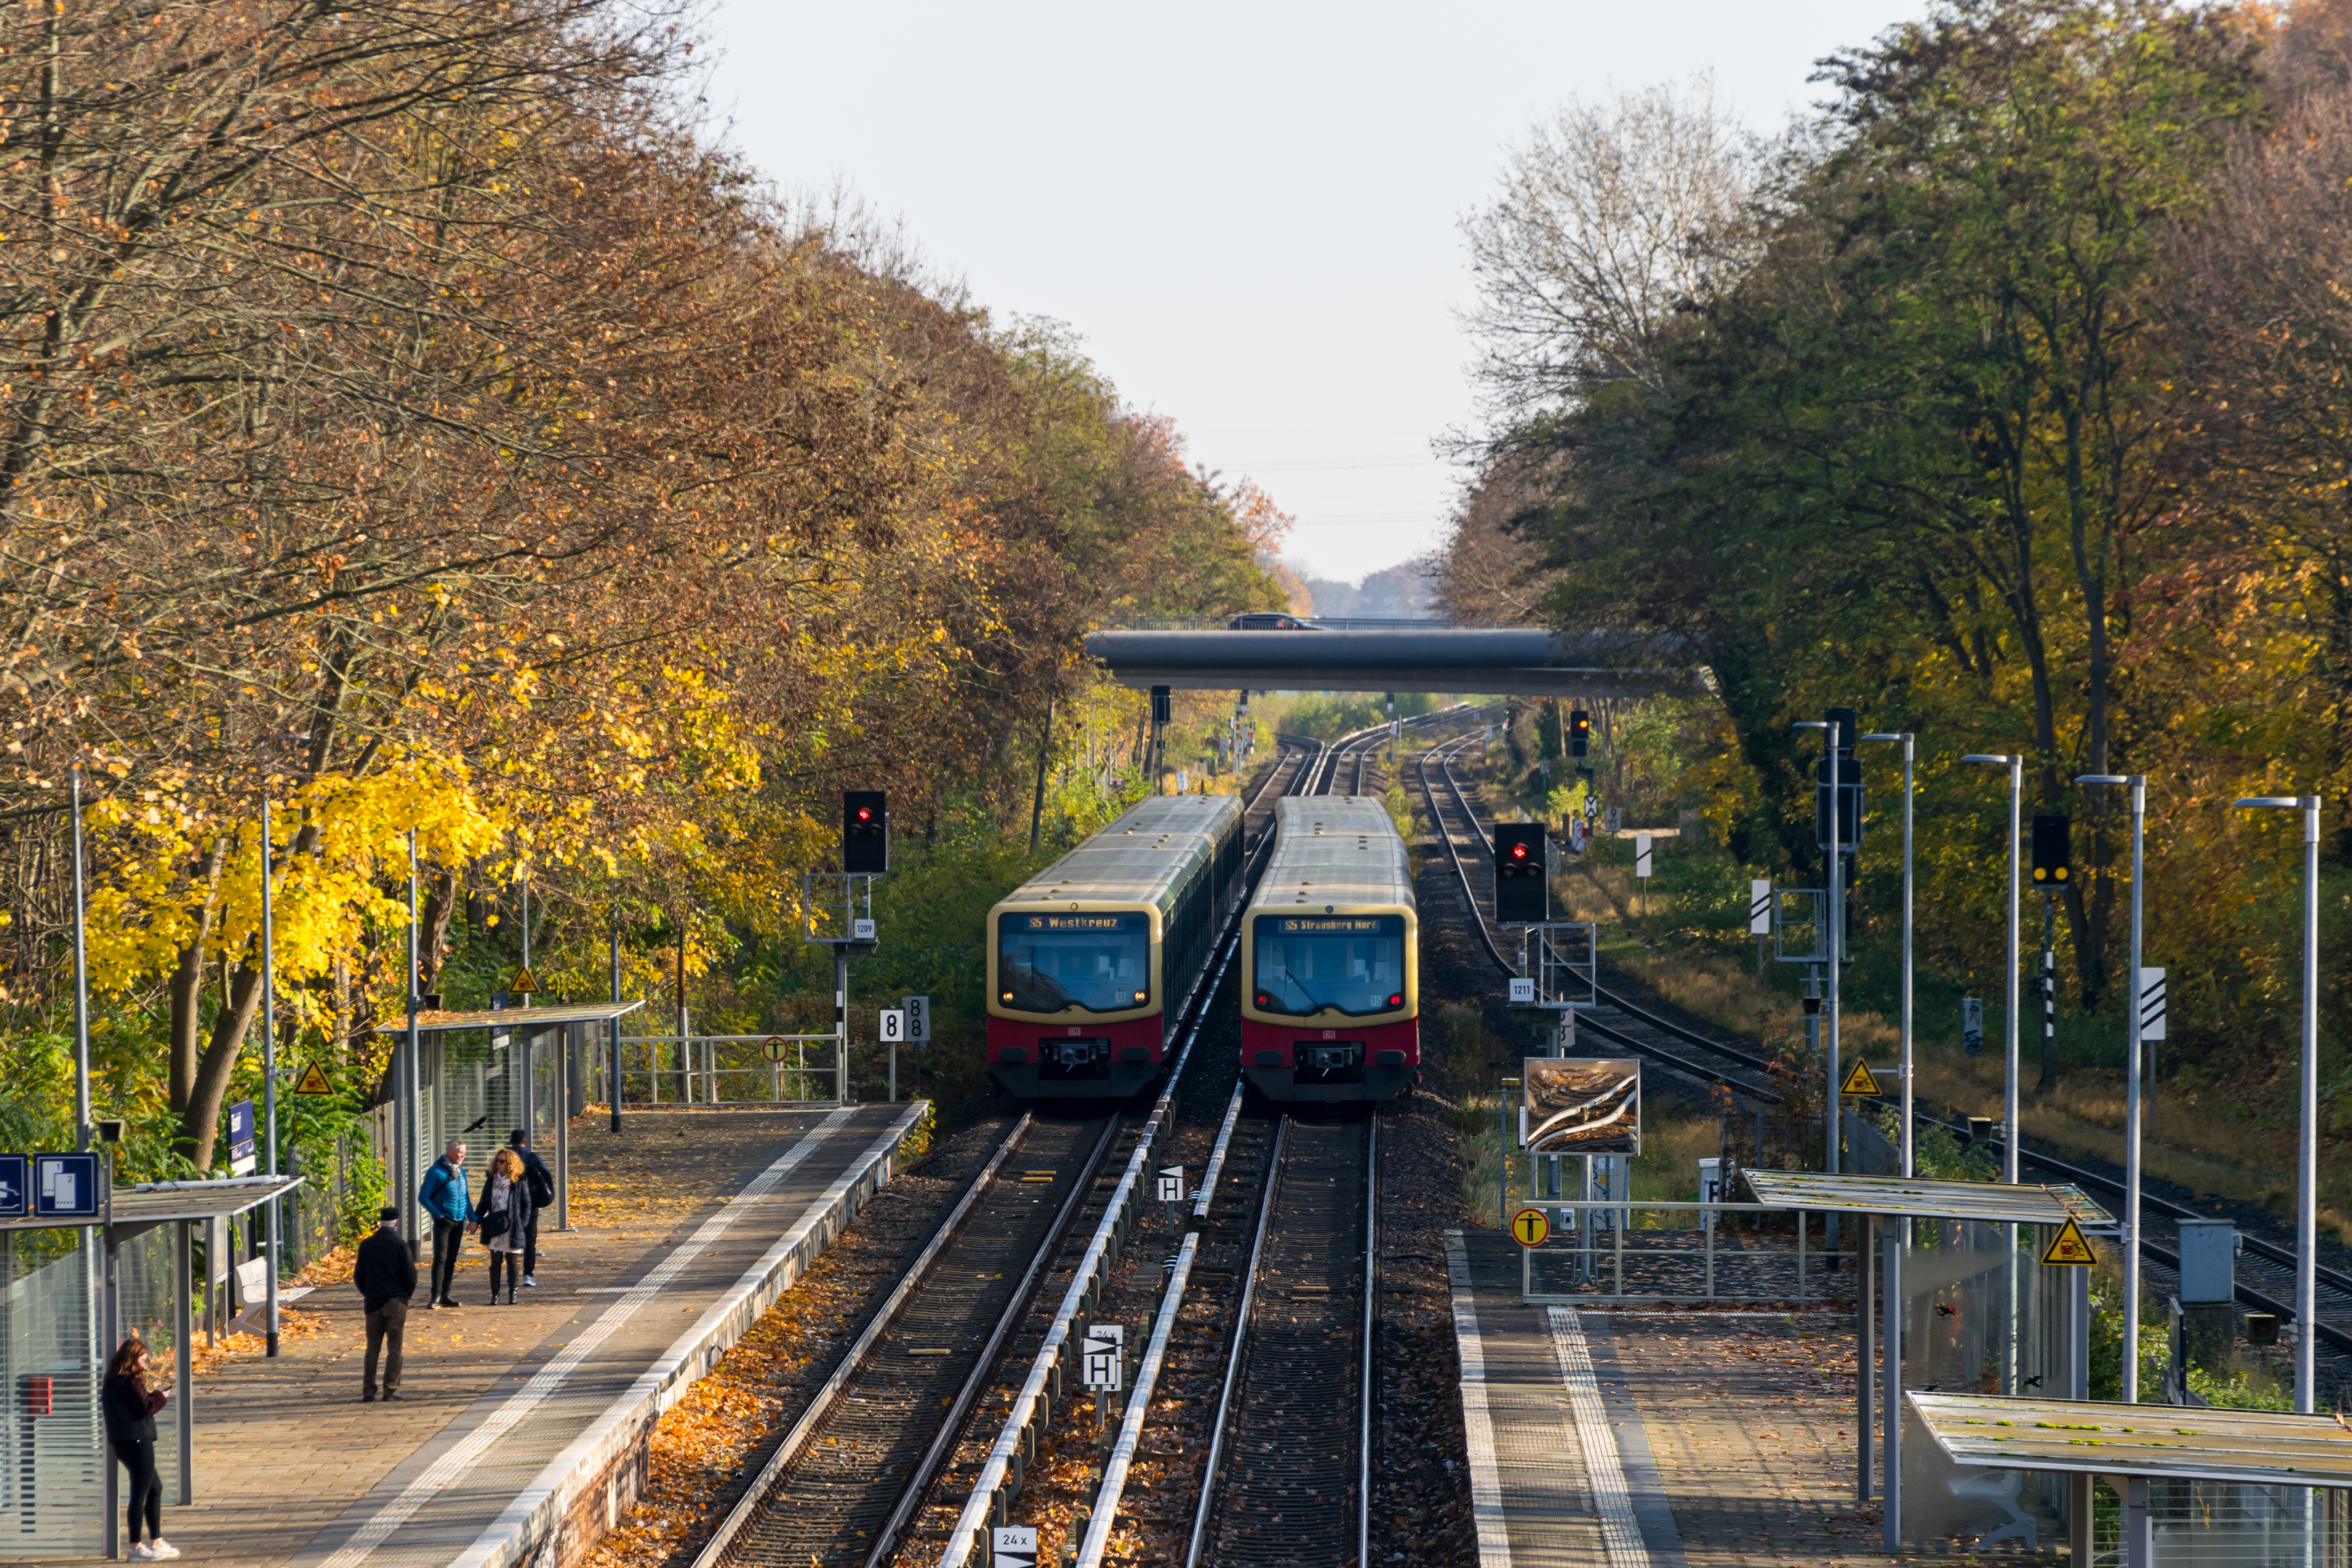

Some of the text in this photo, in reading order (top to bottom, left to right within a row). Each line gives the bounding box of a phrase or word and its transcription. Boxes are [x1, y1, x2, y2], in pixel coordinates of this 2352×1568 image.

[1611, 809, 1616, 819] 9
[1029, 917, 1117, 928] S5 Westkreuz
[1285, 920, 1377, 930] S5 Strausberg Nord
[1514, 986, 1529, 994] 1211
[1371, 996, 1380, 1005] 15
[910, 999, 921, 1016] 8
[887, 1014, 897, 1037] 8
[911, 1019, 922, 1037] 8
[1164, 1180, 1177, 1199] H
[1091, 1356, 1109, 1383] H
[1003, 1534, 1017, 1545] 24
